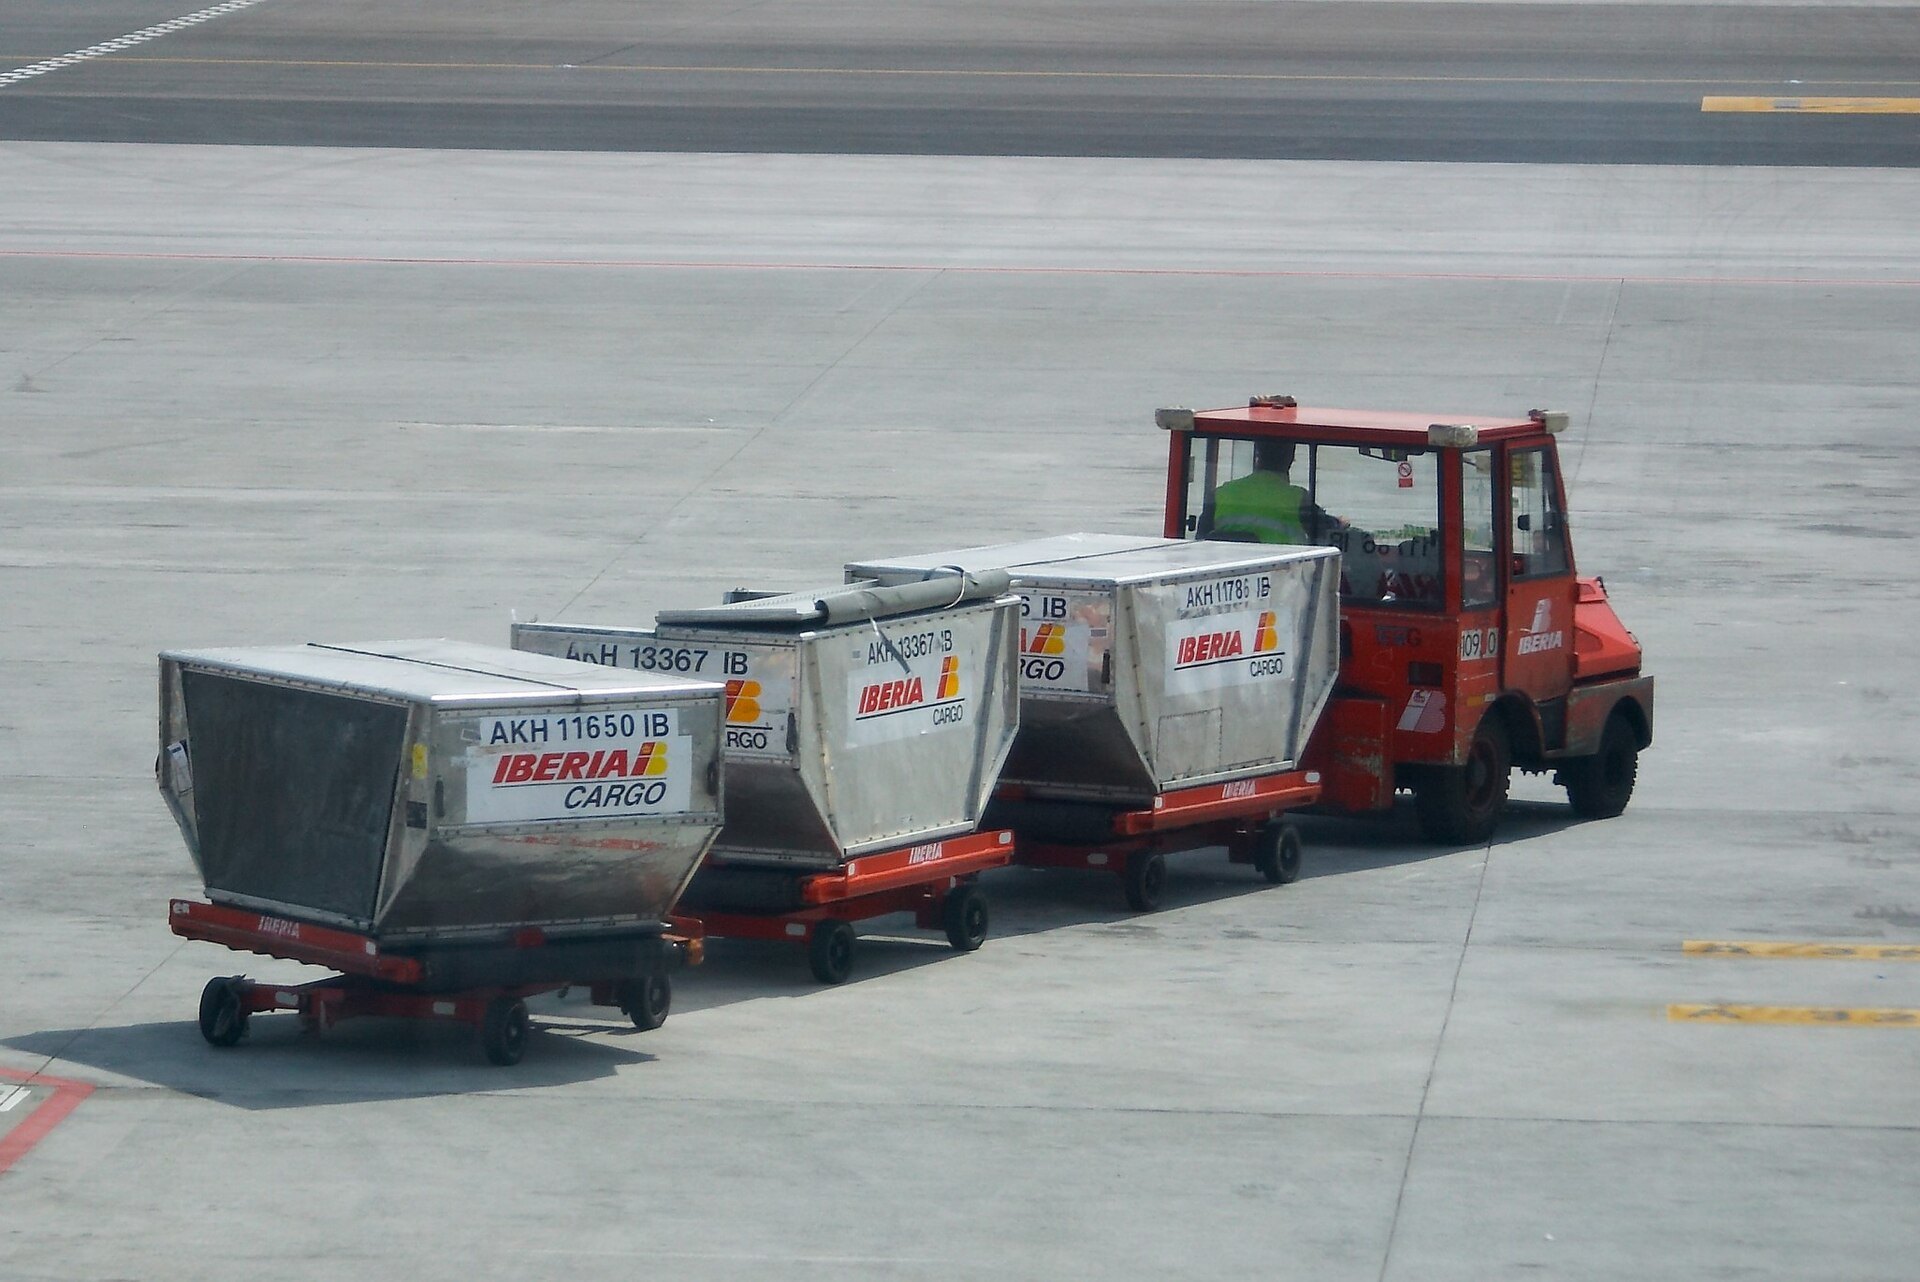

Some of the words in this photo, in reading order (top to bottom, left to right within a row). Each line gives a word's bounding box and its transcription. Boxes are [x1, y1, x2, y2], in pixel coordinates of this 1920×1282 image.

[1186, 584, 1213, 608] AKH
[1256, 576, 1271, 598] IB
[1043, 597, 1067, 618] IB
[1177, 630, 1243, 665] IBERIA
[1517, 630, 1562, 656] IBERIA
[630, 646, 709, 673] 13367
[723, 651, 749, 675] IB
[1250, 658, 1283, 677] CARGO
[858, 676, 924, 715] IBERIA
[490, 718, 548, 745] AKH
[557, 713, 635, 742] 11650
[644, 713, 670, 738] IB
[932, 704, 963, 726] CARGO
[492, 750, 628, 783] IBERIA
[564, 781, 667, 809] CARGO
[908, 841, 943, 865] IBERIA
